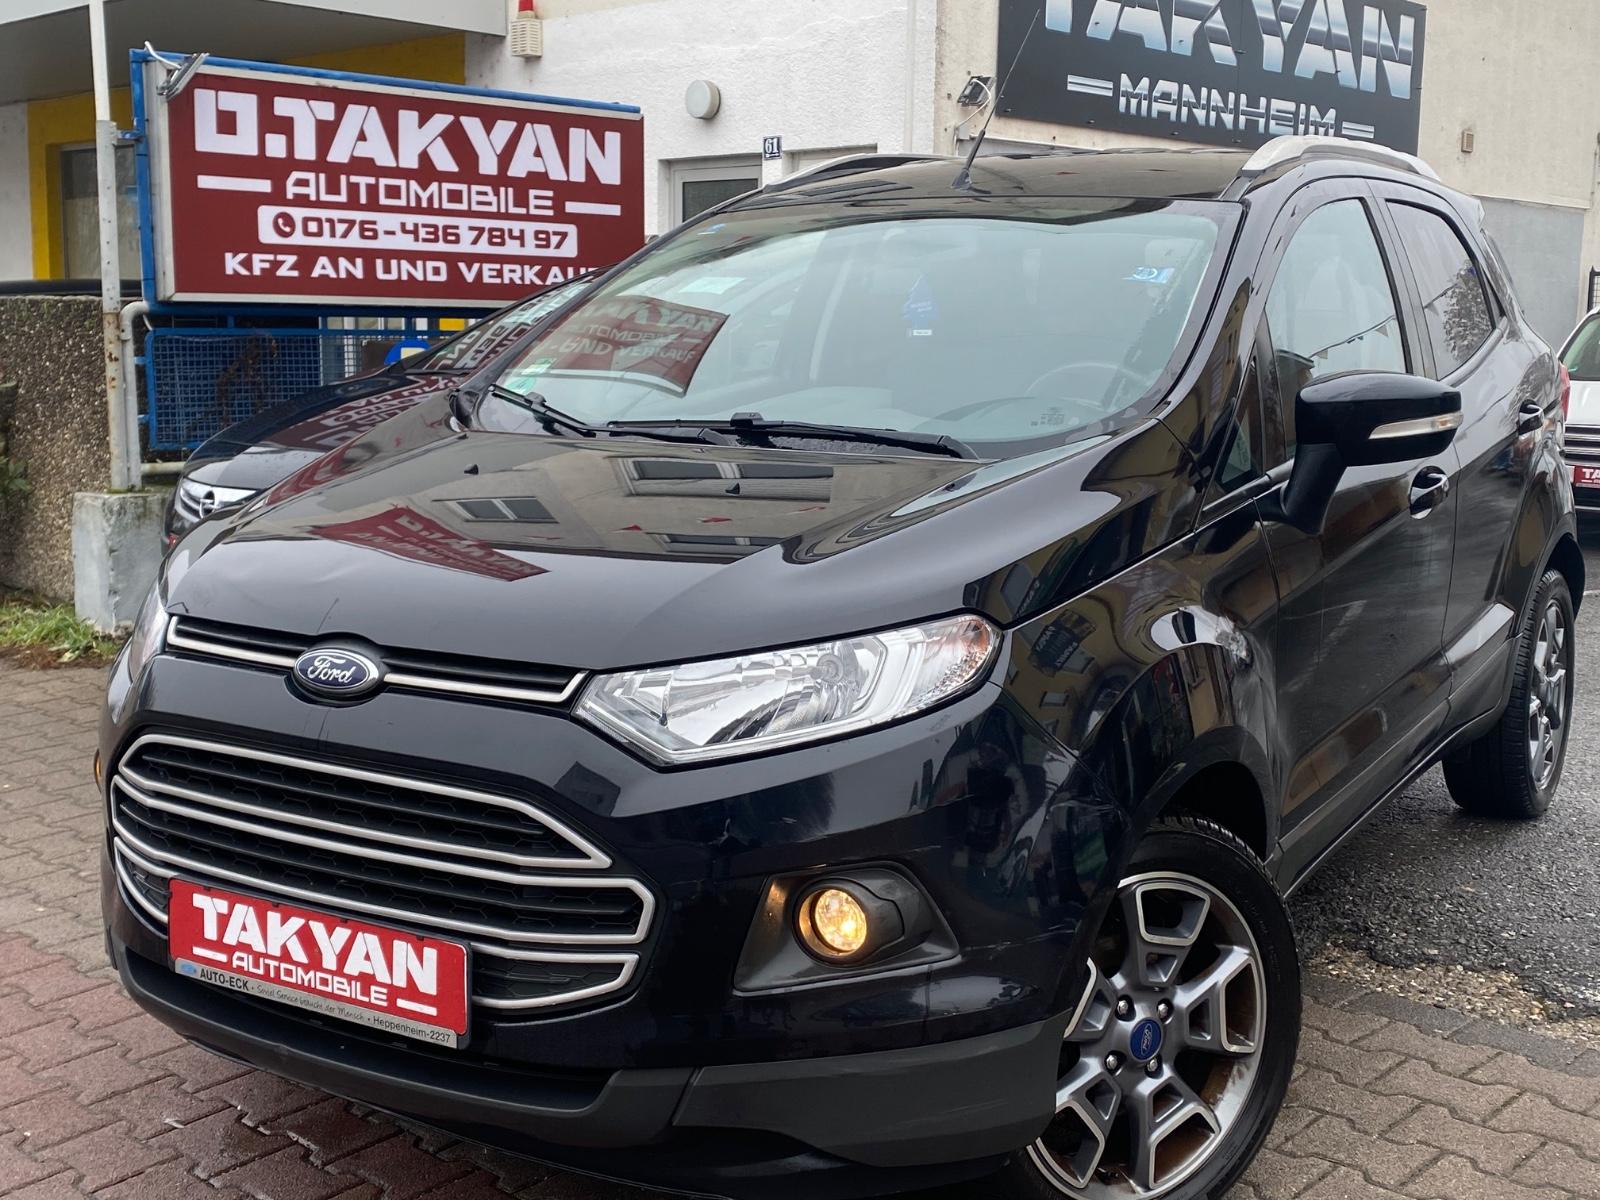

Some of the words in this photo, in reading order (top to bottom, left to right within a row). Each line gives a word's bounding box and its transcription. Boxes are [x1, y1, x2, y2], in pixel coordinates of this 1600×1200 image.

[1119, 72, 1337, 137] MANNHEIM
[764, 137, 779, 154] 61
[286, 171, 554, 216] AUTOMOBILE
[468, 225, 526, 248] 784
[534, 230, 569, 250] 97
[224, 252, 299, 277] KFZ
[310, 256, 364, 280] AN
[375, 258, 448, 282] UND
[457, 261, 599, 286] VERKA
[307, 655, 357, 684] Ford
[192, 893, 438, 996] TAKYAN
[232, 951, 389, 1007] AUTOMOBILE
[200, 968, 249, 991] AUTO-ECK
[372, 1015, 451, 1044] Heppenheim-2237
